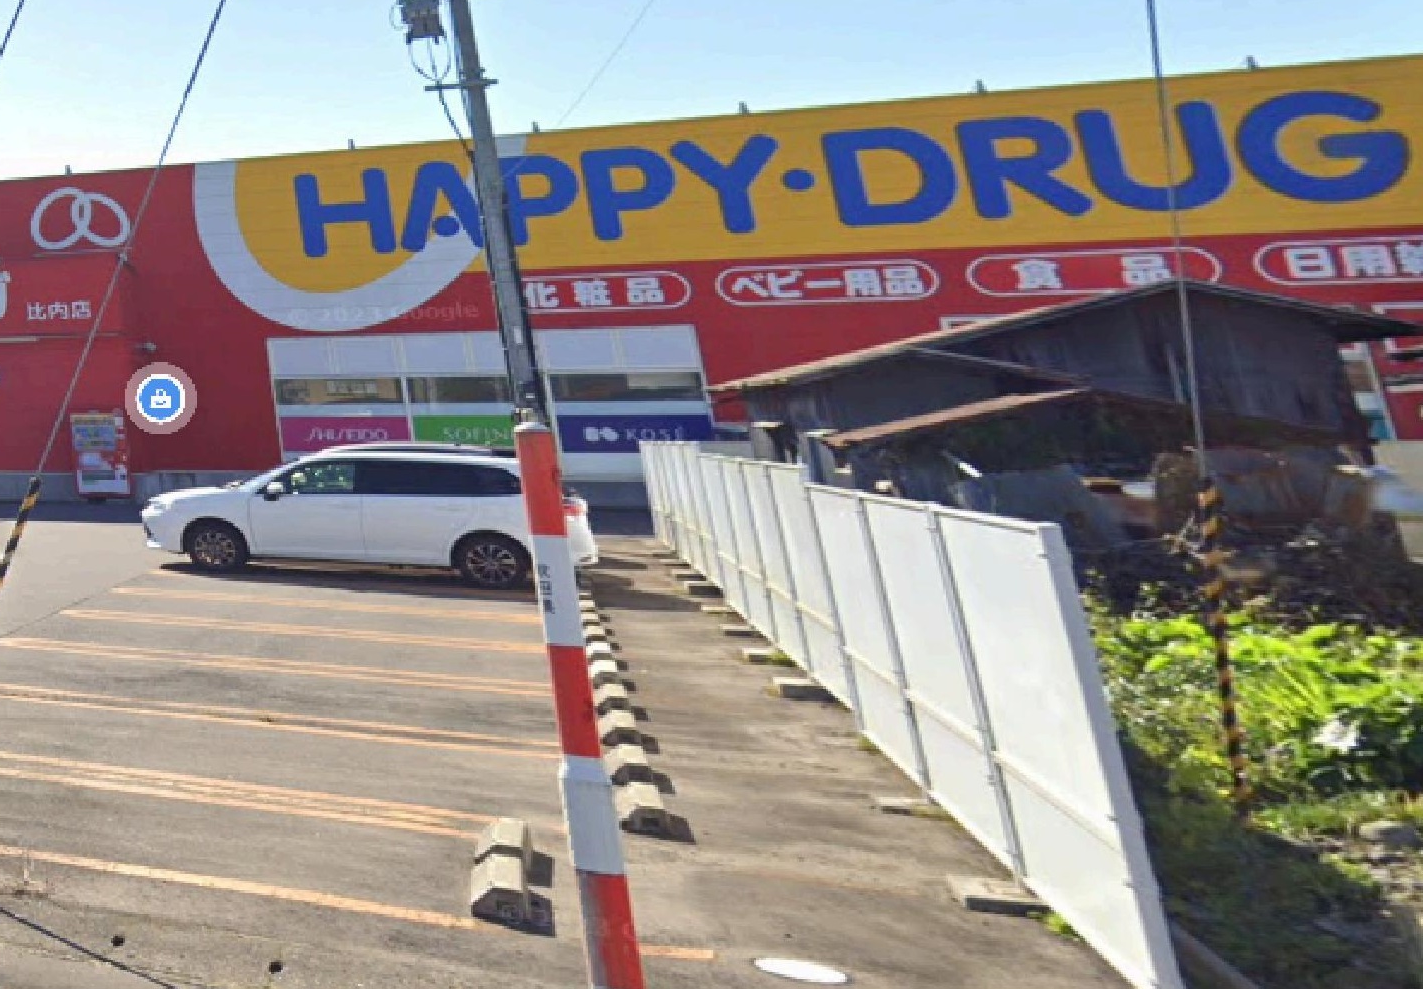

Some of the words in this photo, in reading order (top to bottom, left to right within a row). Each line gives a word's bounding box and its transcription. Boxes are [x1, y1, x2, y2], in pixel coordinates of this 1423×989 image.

[523, 275, 668, 309] 化粧品
[729, 264, 925, 301] ベビー用品
[442, 427, 514, 441] SOFIN
